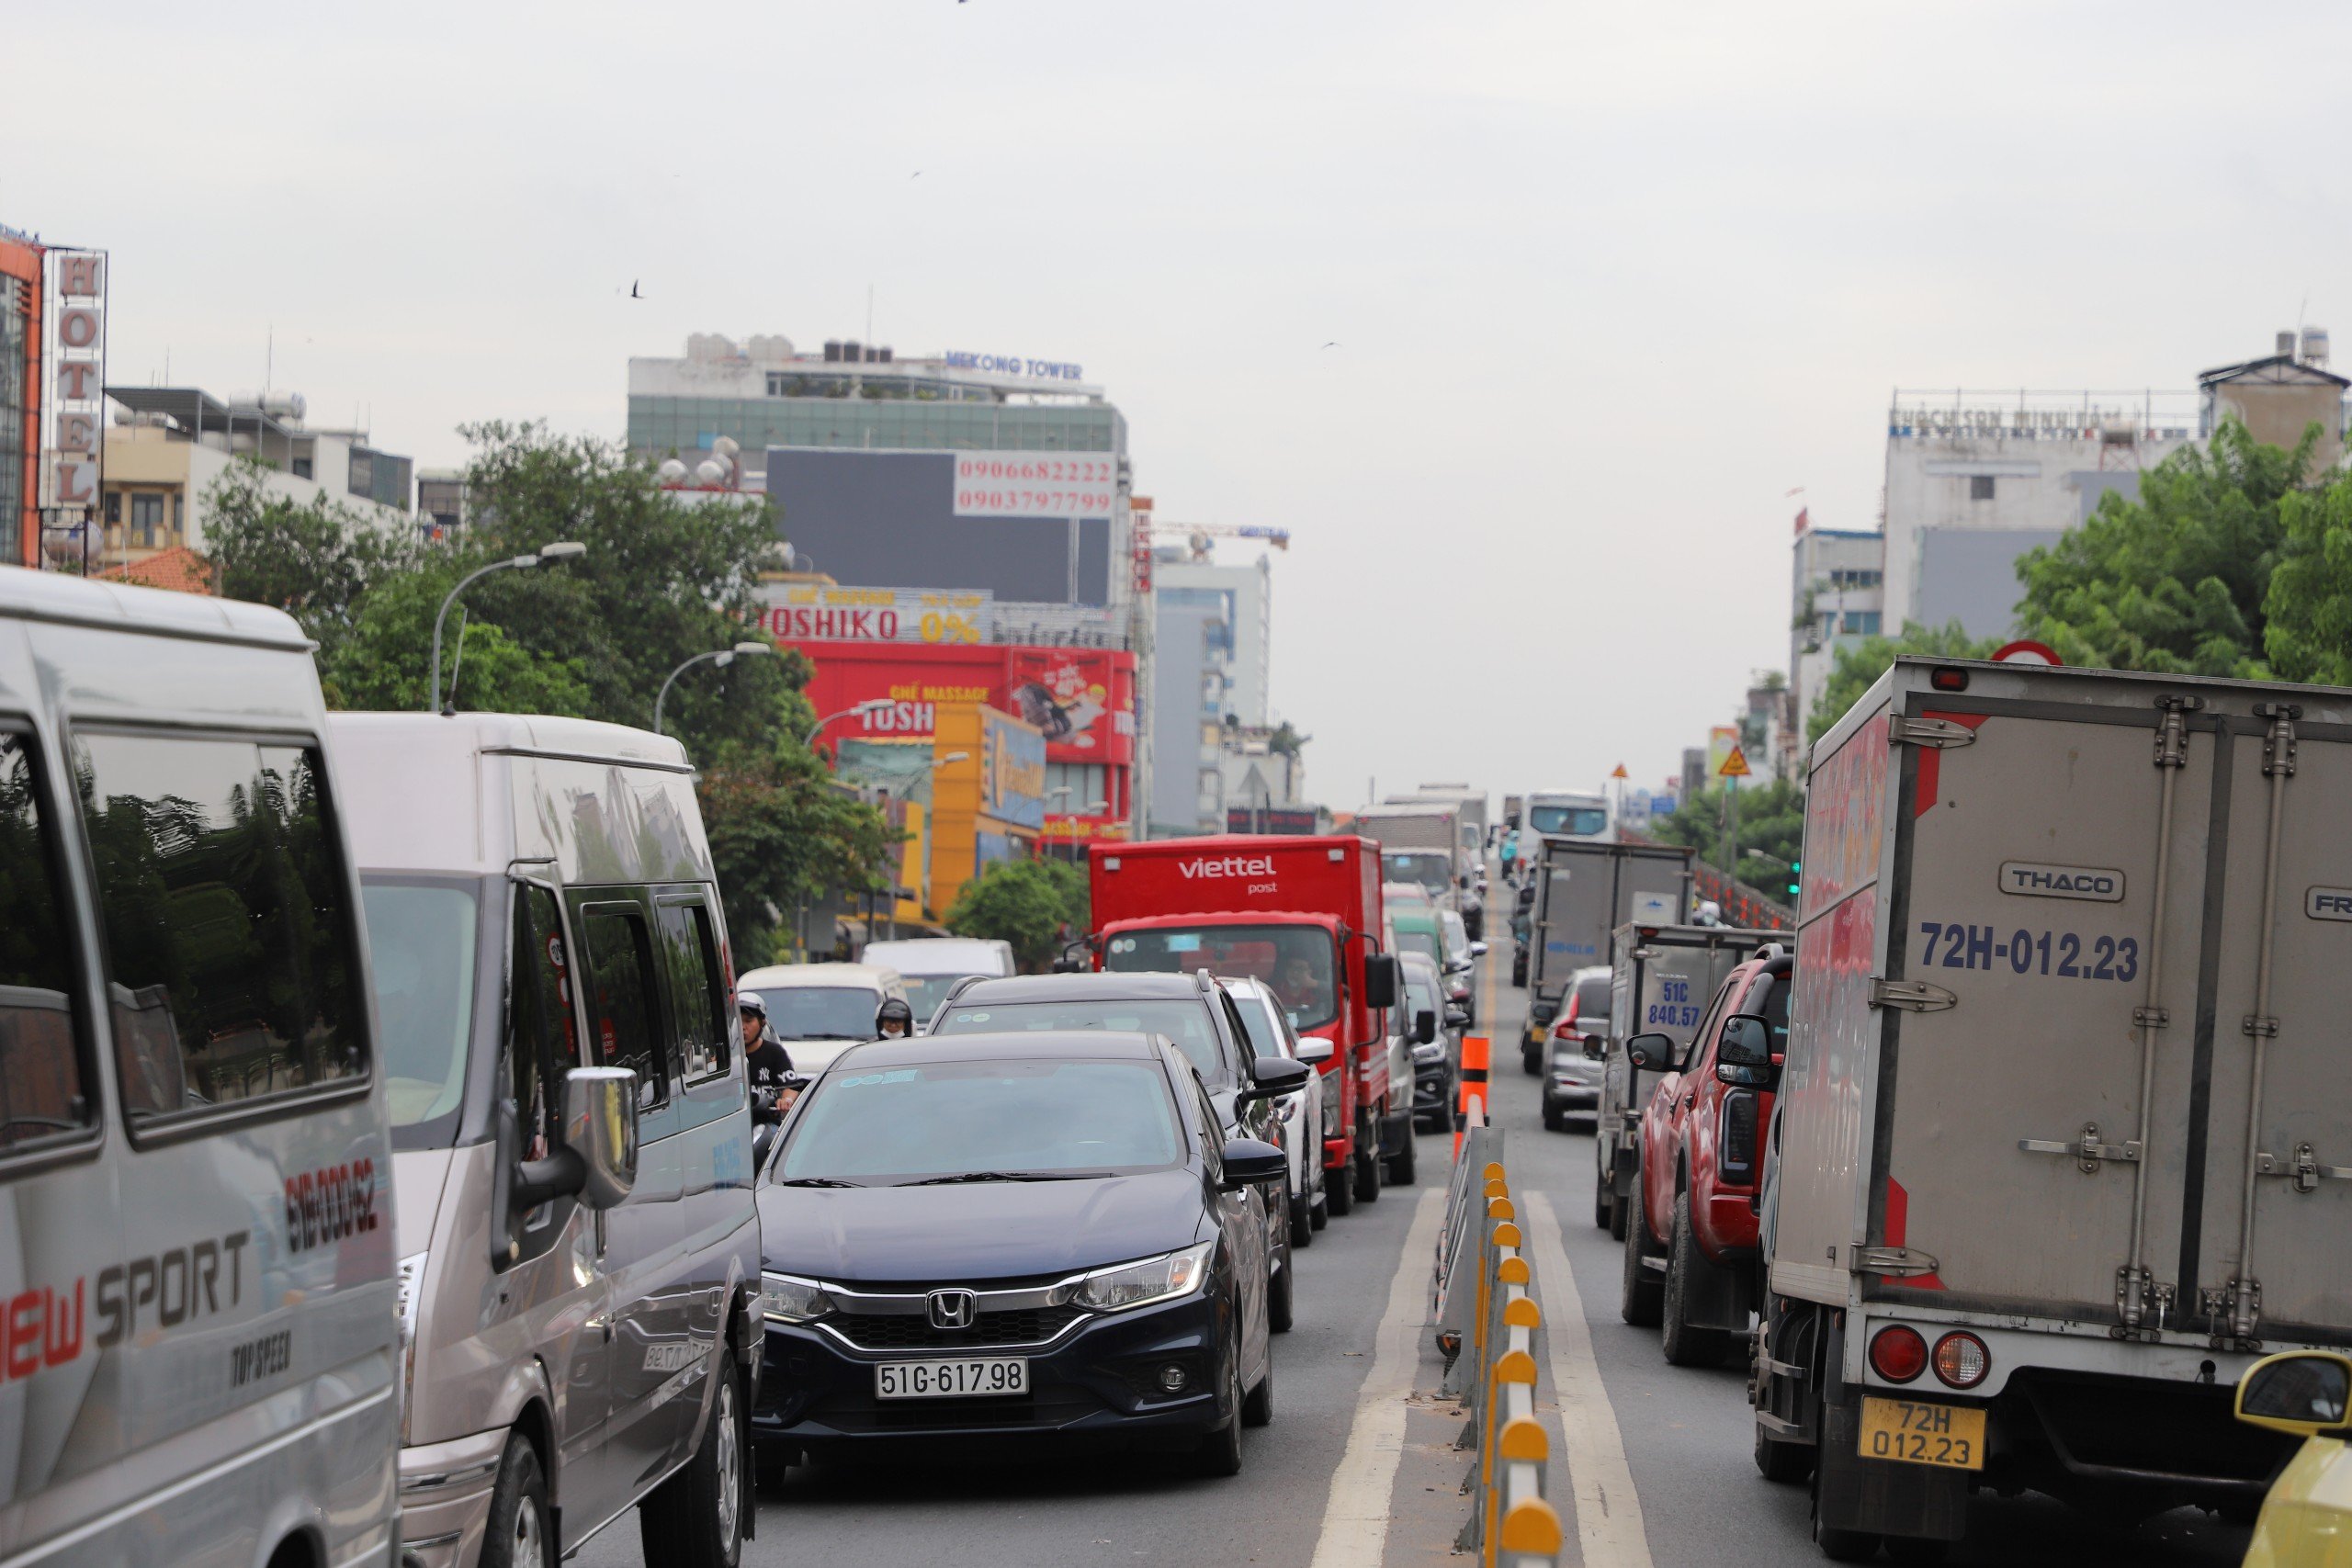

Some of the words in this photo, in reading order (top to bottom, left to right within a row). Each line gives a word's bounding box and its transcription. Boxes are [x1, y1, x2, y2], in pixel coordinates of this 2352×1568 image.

[56, 256, 98, 502] HOTEL
[946, 350, 1022, 374] MEKONG
[1026, 358, 1083, 380] TOWER
[960, 460, 1110, 482] 0906682222
[959, 490, 1111, 511] 0903797799
[921, 612, 982, 644] 0%
[922, 686, 989, 702] MASSAGE
[1178, 855, 1277, 879] viettel
[2012, 869, 2114, 894] THACO
[1248, 881, 1278, 896] post
[1921, 921, 2139, 983] 72H-012.23
[1663, 981, 1689, 1003] 51C
[1648, 1004, 1700, 1028] 840.57
[96, 1229, 251, 1348] SPORT
[232, 1342, 254, 1388] TOP
[256, 1328, 292, 1380] SPEED
[881, 1362, 1022, 1394] 51G-617.98
[1898, 1403, 1951, 1433] 72H
[1872, 1430, 1971, 1464] 012.23
